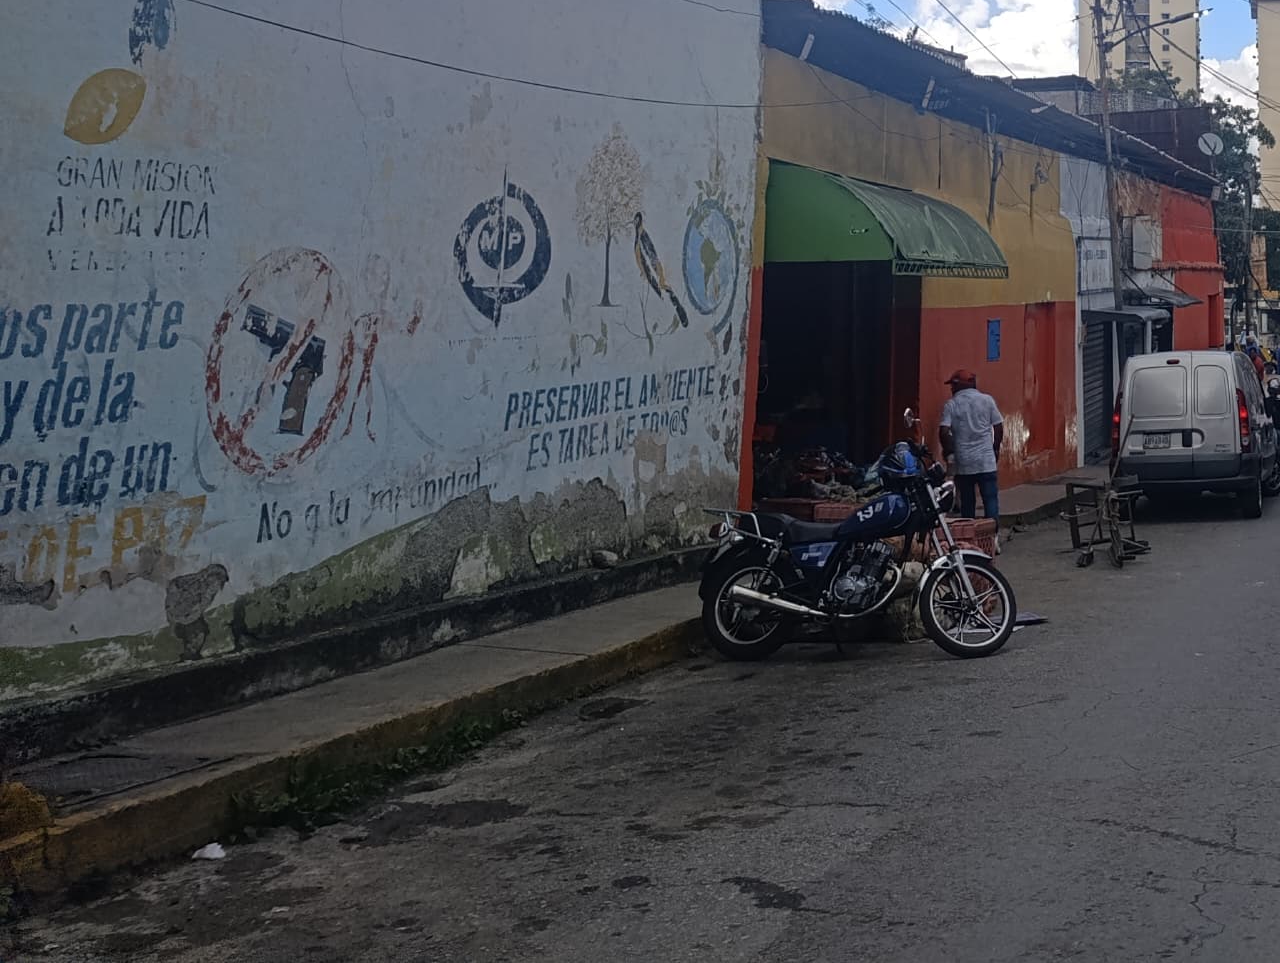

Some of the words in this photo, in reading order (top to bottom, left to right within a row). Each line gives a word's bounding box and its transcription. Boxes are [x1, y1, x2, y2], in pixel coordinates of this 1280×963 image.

[57, 156, 123, 189] GRAN
[154, 200, 209, 238] VIDA
[52, 288, 184, 369] parte
[0, 380, 29, 443] y
[504, 380, 610, 432] PRESERVAR
[614, 377, 634, 412] EL
[57, 436, 114, 506] de
[526, 432, 553, 472] ES
[559, 422, 610, 465] TAREA
[257, 500, 291, 543] No
